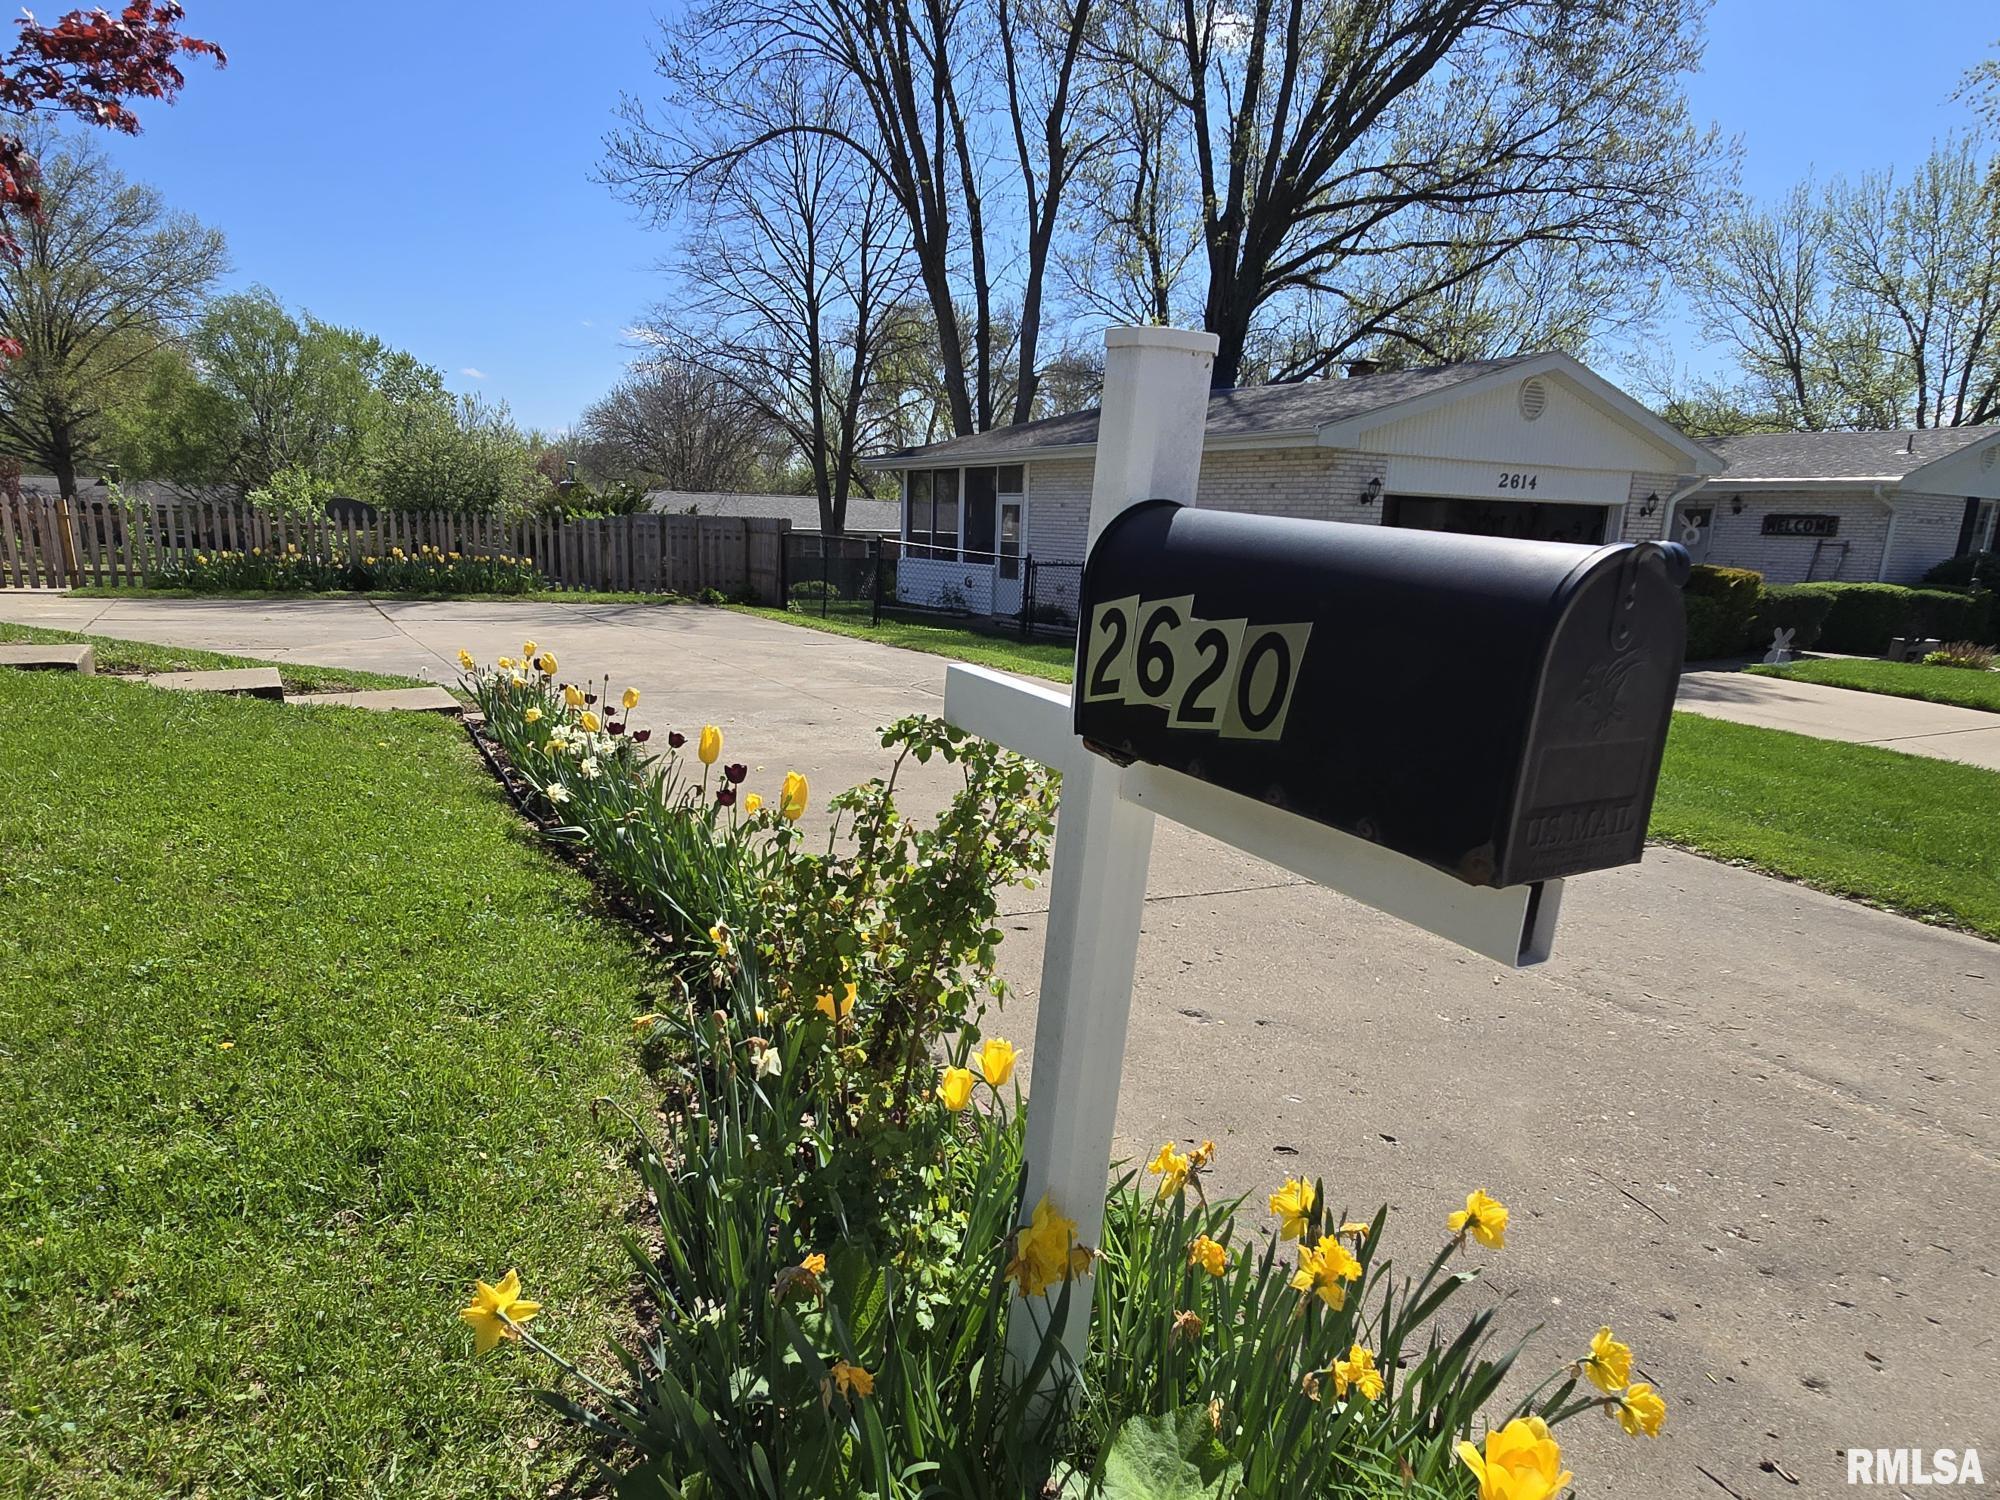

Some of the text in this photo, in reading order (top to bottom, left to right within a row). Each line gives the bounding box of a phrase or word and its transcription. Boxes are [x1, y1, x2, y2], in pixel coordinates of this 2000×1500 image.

[1498, 473, 1537, 490] 2614
[1765, 519, 1836, 533] WELCOME
[1090, 606, 1291, 732] 2620
[1570, 804, 1636, 842] MAIL
